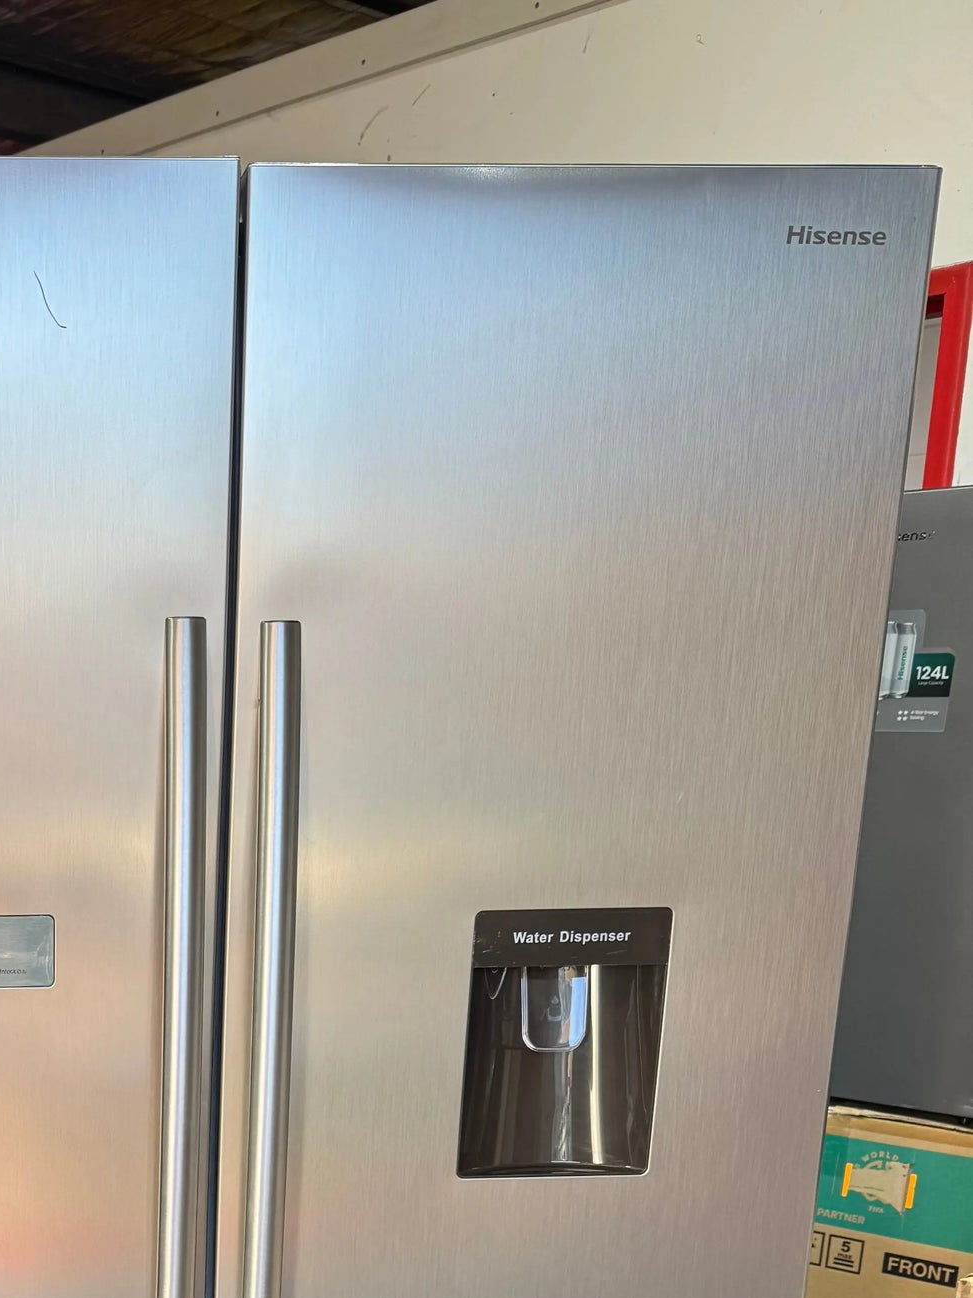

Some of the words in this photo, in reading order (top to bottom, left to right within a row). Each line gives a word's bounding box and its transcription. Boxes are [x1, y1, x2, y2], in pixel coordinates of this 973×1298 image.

[786, 226, 886, 245] Hisense
[897, 646, 908, 680] Hisense
[916, 666, 949, 680] 124L
[513, 931, 554, 944] Water
[559, 930, 631, 944] Dispenser
[861, 1151, 898, 1161] WORLD
[817, 1208, 865, 1224] PARTNER
[840, 1241, 851, 1253] 5
[887, 1257, 954, 1283] FRONT
